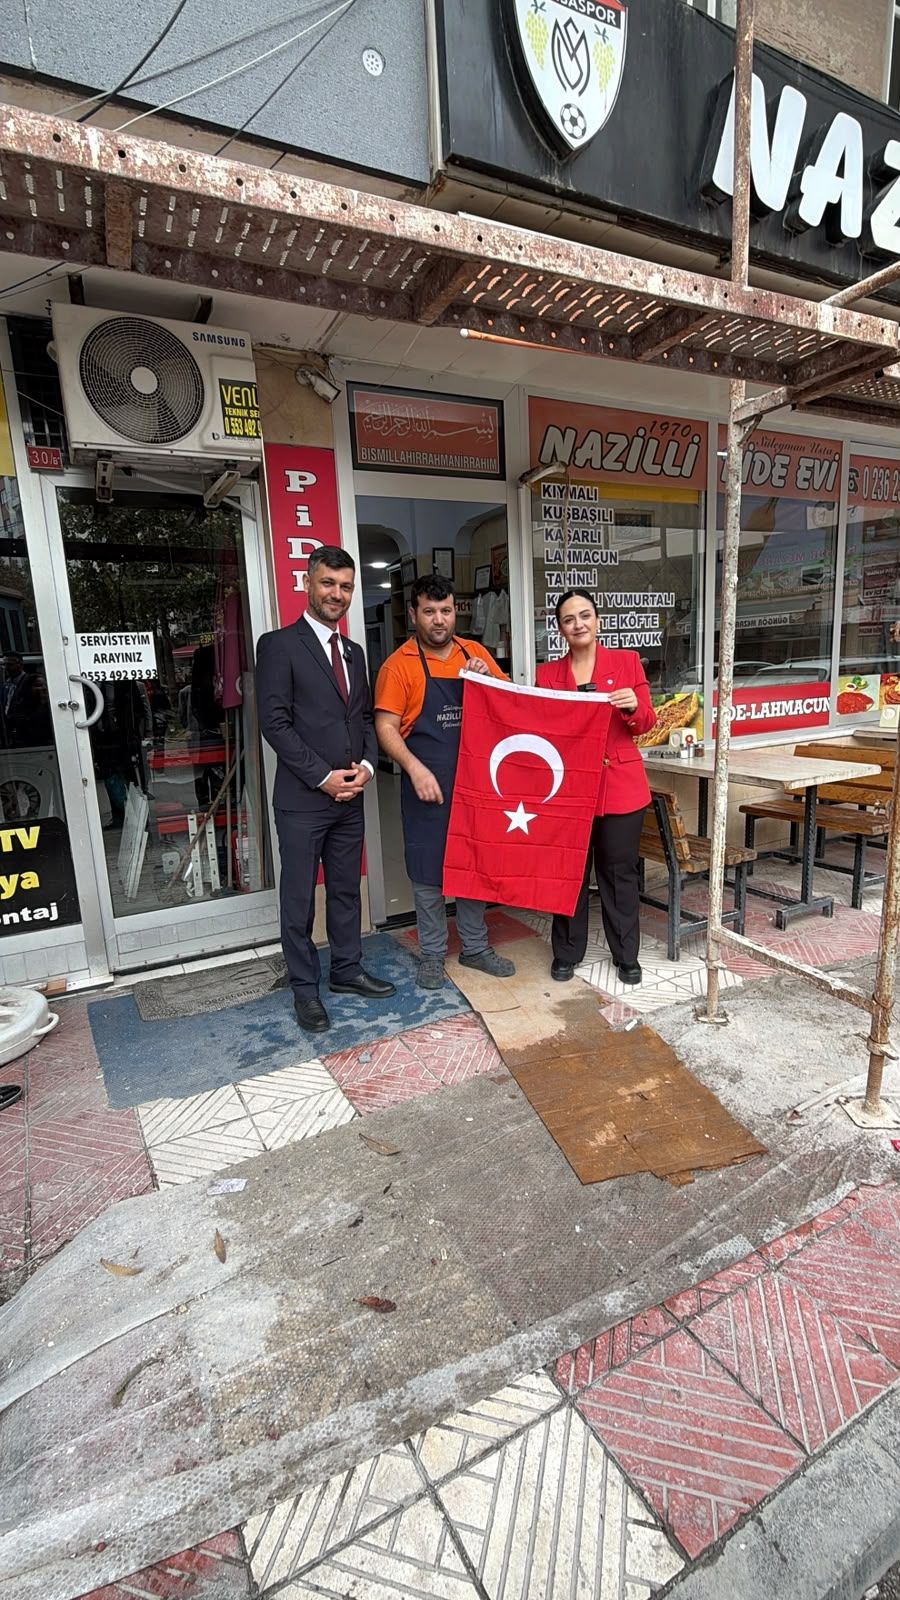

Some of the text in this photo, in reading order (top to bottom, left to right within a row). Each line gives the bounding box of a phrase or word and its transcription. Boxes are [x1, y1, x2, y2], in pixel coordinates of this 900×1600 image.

[192, 331, 246, 348] SAMSUNG
[224, 416, 231, 434] 0
[230, 417, 244, 435] 553
[244, 419, 257, 436] 492
[649, 420, 692, 438] 1970
[796, 452, 840, 492] EVİ
[541, 483, 598, 502] KIYMALI
[863, 466, 900, 502] 0 236 2
[542, 504, 615, 526] KUŞBAŞILI
[544, 527, 602, 546] KAŞARLI
[545, 549, 619, 565] LAHMACUN
[545, 569, 598, 587] TAHİNLİ
[605, 593, 675, 608] YUMURTALI
[619, 612, 659, 629] KÖFTE
[622, 632, 662, 647] TAVUK
[93, 652, 143, 664] ARAYINIZ
[81, 668, 159, 681] 0553 492 93 93
[712, 697, 830, 723] PDE-LAHMACUN
[0, 902, 59, 926] ntaj
